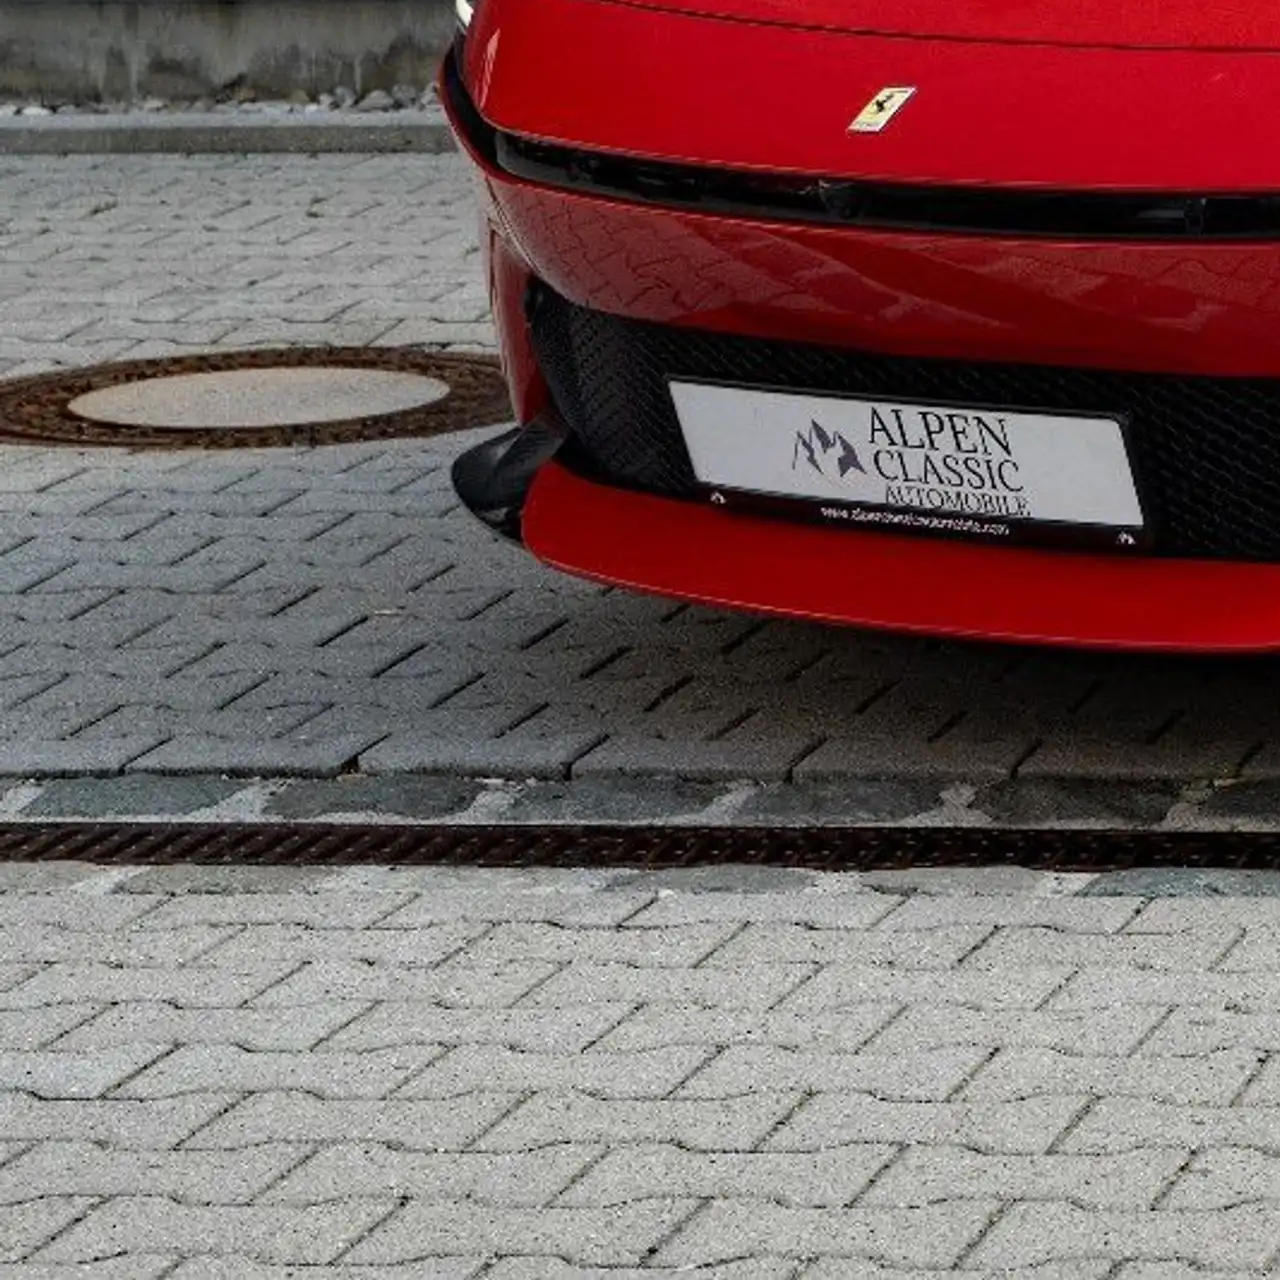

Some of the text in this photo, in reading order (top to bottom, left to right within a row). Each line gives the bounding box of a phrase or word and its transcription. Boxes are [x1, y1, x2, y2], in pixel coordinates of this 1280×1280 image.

[868, 406, 1012, 457] ALPEN
[873, 449, 1024, 492] CLASSIC
[886, 485, 1031, 517] AUTOMOBILE
